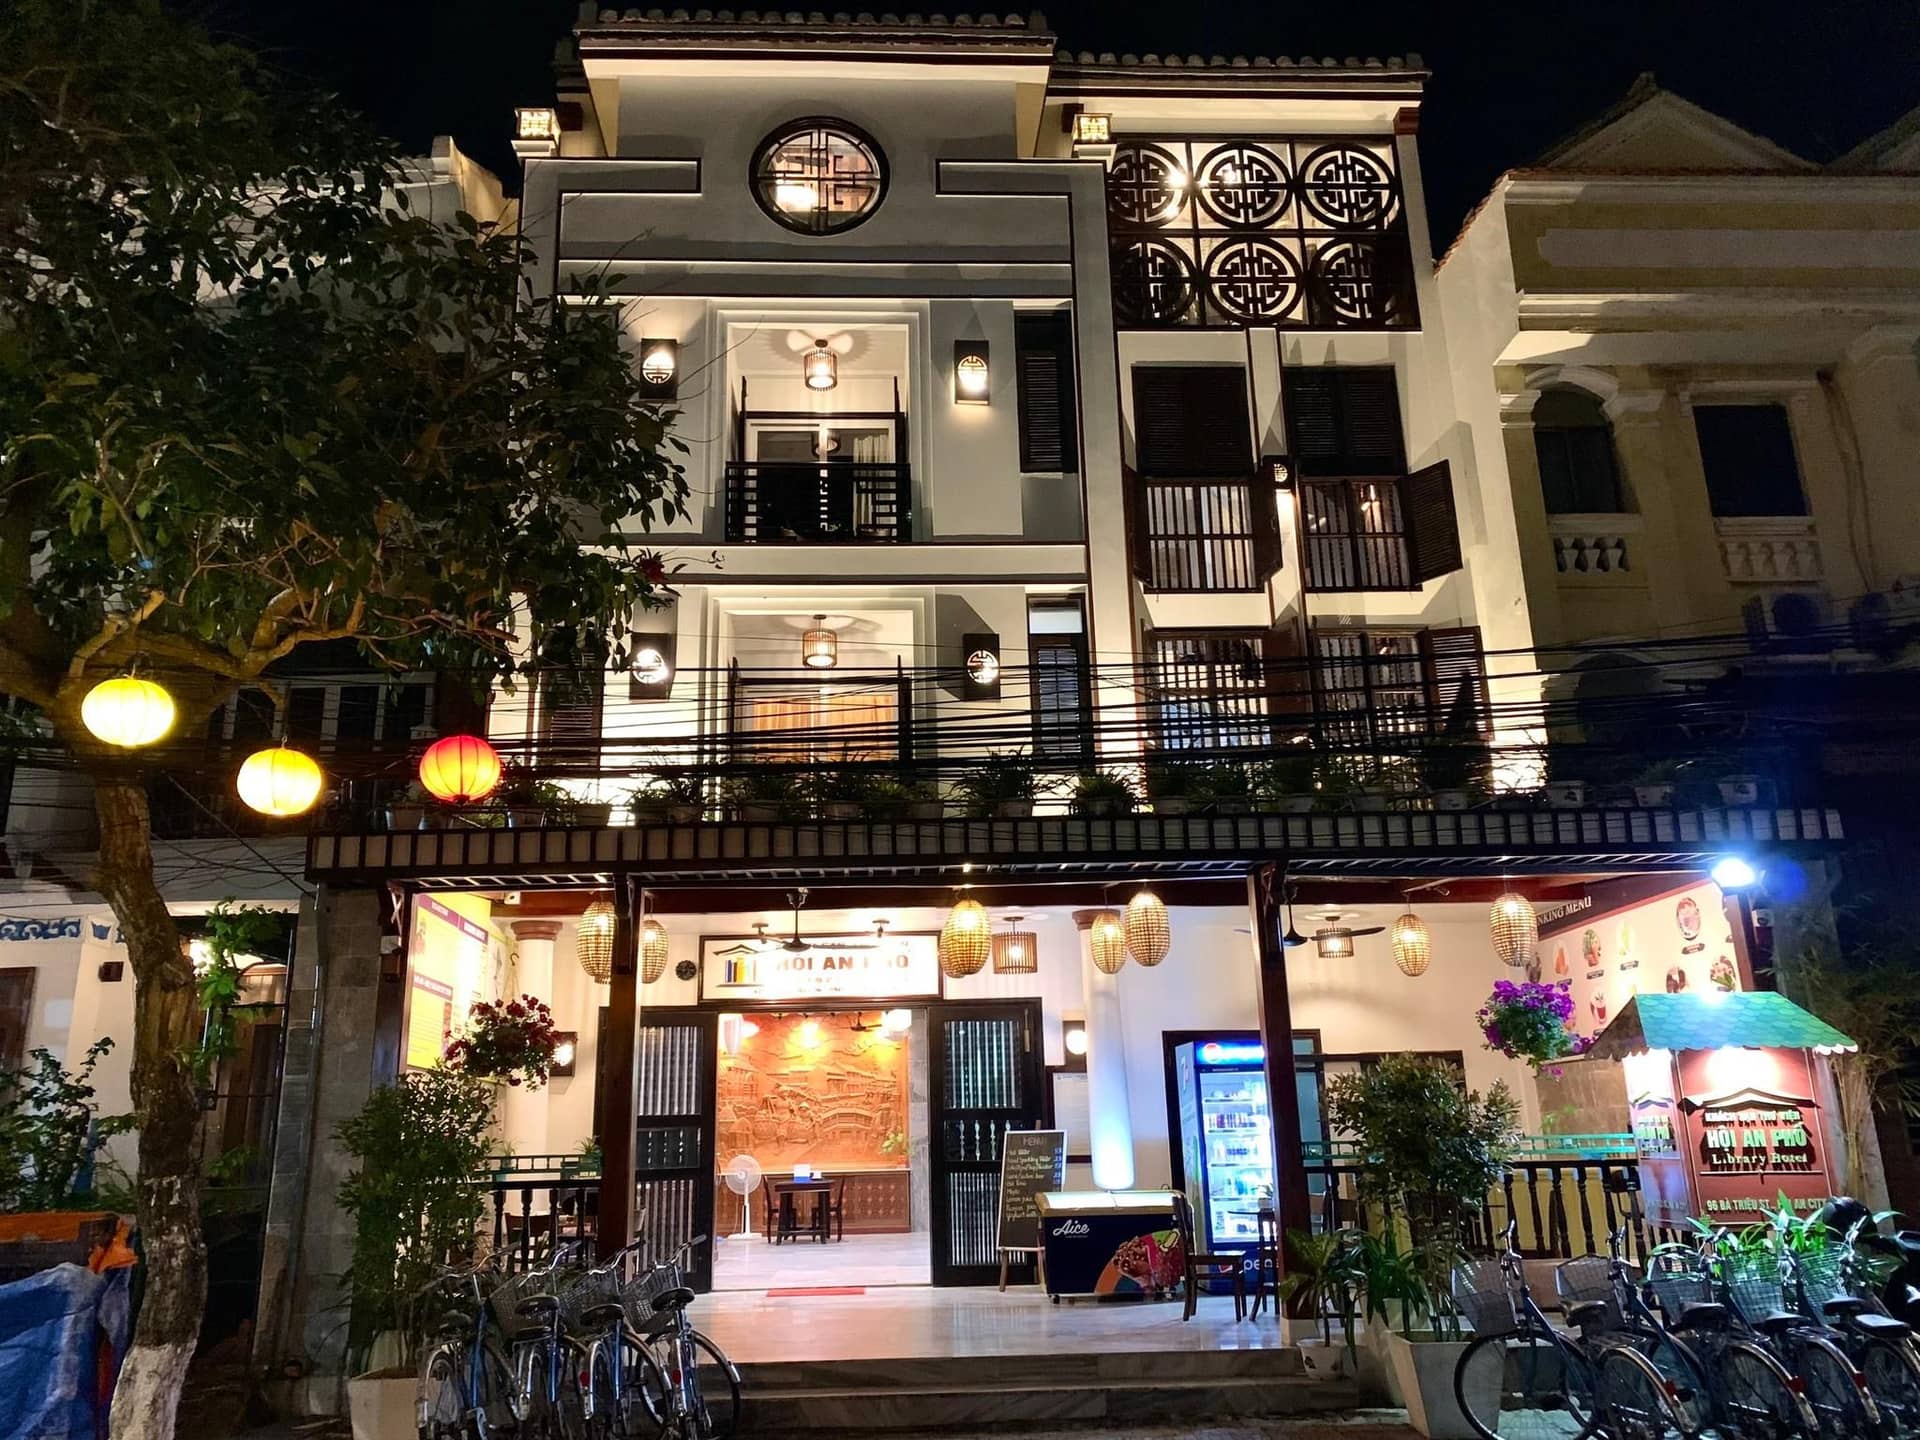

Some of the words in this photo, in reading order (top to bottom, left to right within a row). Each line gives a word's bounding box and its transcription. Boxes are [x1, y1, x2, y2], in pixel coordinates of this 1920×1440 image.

[1537, 906, 1564, 926] NKING
[1565, 896, 1592, 916] MENU
[823, 956, 853, 970] AN
[1743, 1129, 1766, 1147] AN
[1771, 1121, 1808, 1147] PHỐ
[1711, 1153, 1766, 1167] Library
[1771, 1153, 1808, 1163] Hotel
[1052, 1219, 1090, 1236] Aice
